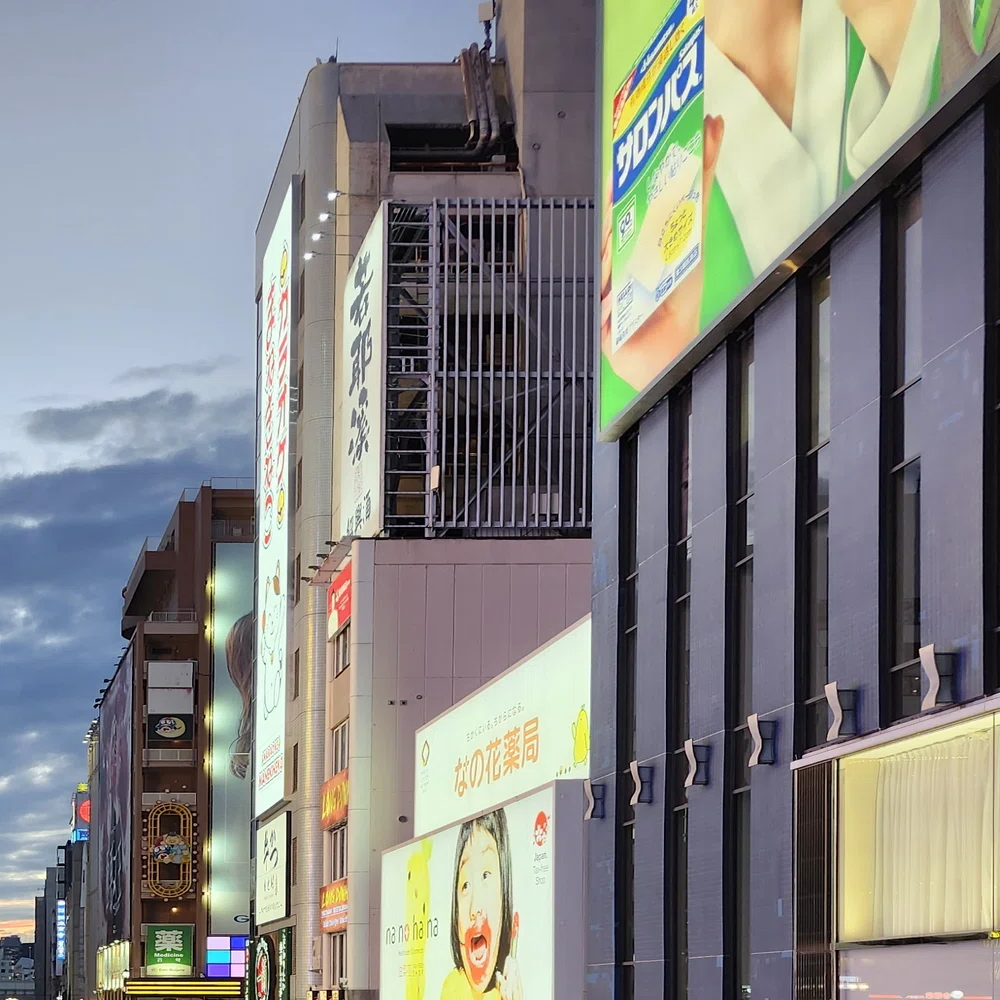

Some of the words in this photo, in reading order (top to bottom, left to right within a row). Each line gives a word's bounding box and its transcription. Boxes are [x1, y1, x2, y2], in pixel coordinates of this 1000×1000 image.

[616, 42, 699, 188] サロンパス
[454, 716, 539, 798] なの花薬局
[154, 929, 184, 952] 薬
